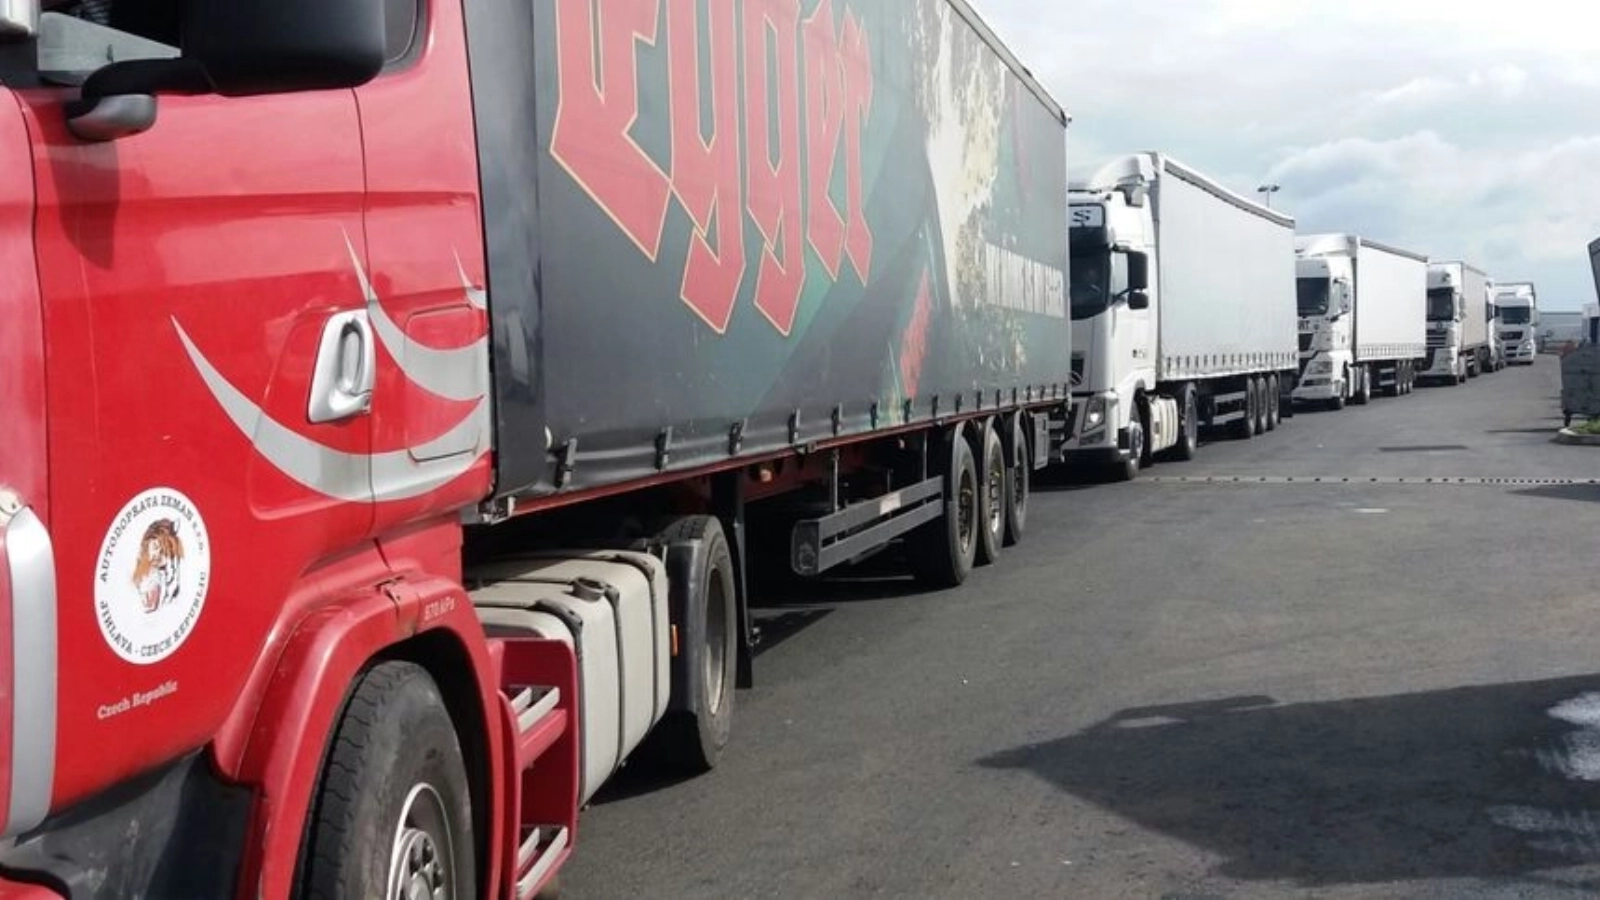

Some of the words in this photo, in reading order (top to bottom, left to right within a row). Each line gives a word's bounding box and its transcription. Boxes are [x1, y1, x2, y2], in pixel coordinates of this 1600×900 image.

[141, 636, 172, 657] CZECH
[173, 571, 207, 642] REPUBLIC
[97, 697, 130, 720] Czech
[132, 680, 178, 707] Republic
